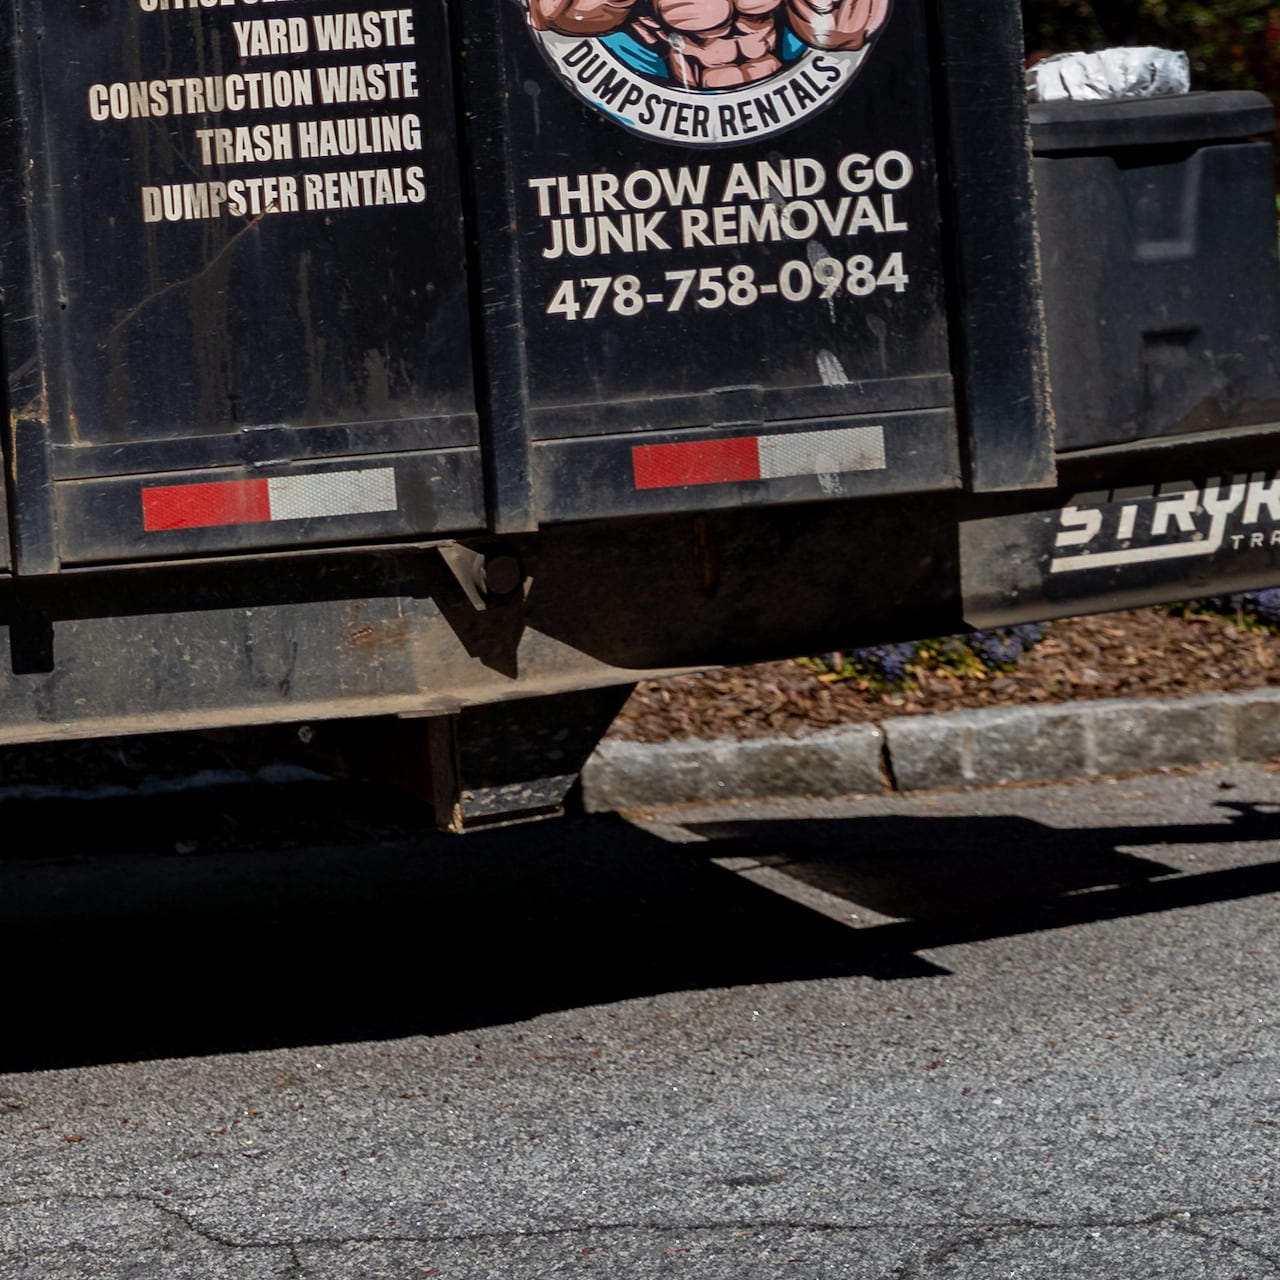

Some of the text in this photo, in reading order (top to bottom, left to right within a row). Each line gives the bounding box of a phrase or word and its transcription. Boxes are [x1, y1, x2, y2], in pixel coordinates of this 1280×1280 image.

[233, 9, 415, 57] YARD WASTE
[88, 61, 419, 121] CONSTRUCTION WASTE
[562, 39, 842, 138] DUMPSTER RENTALS
[197, 114, 422, 165] TRASH HAULING
[141, 166, 425, 223] DUMPSTER RENTALS
[528, 150, 913, 217] THROW AND GO
[542, 193, 908, 259] JUNK REMOVAL
[546, 251, 909, 320] 478-758-0984
[1051, 470, 1280, 573] STRYK
